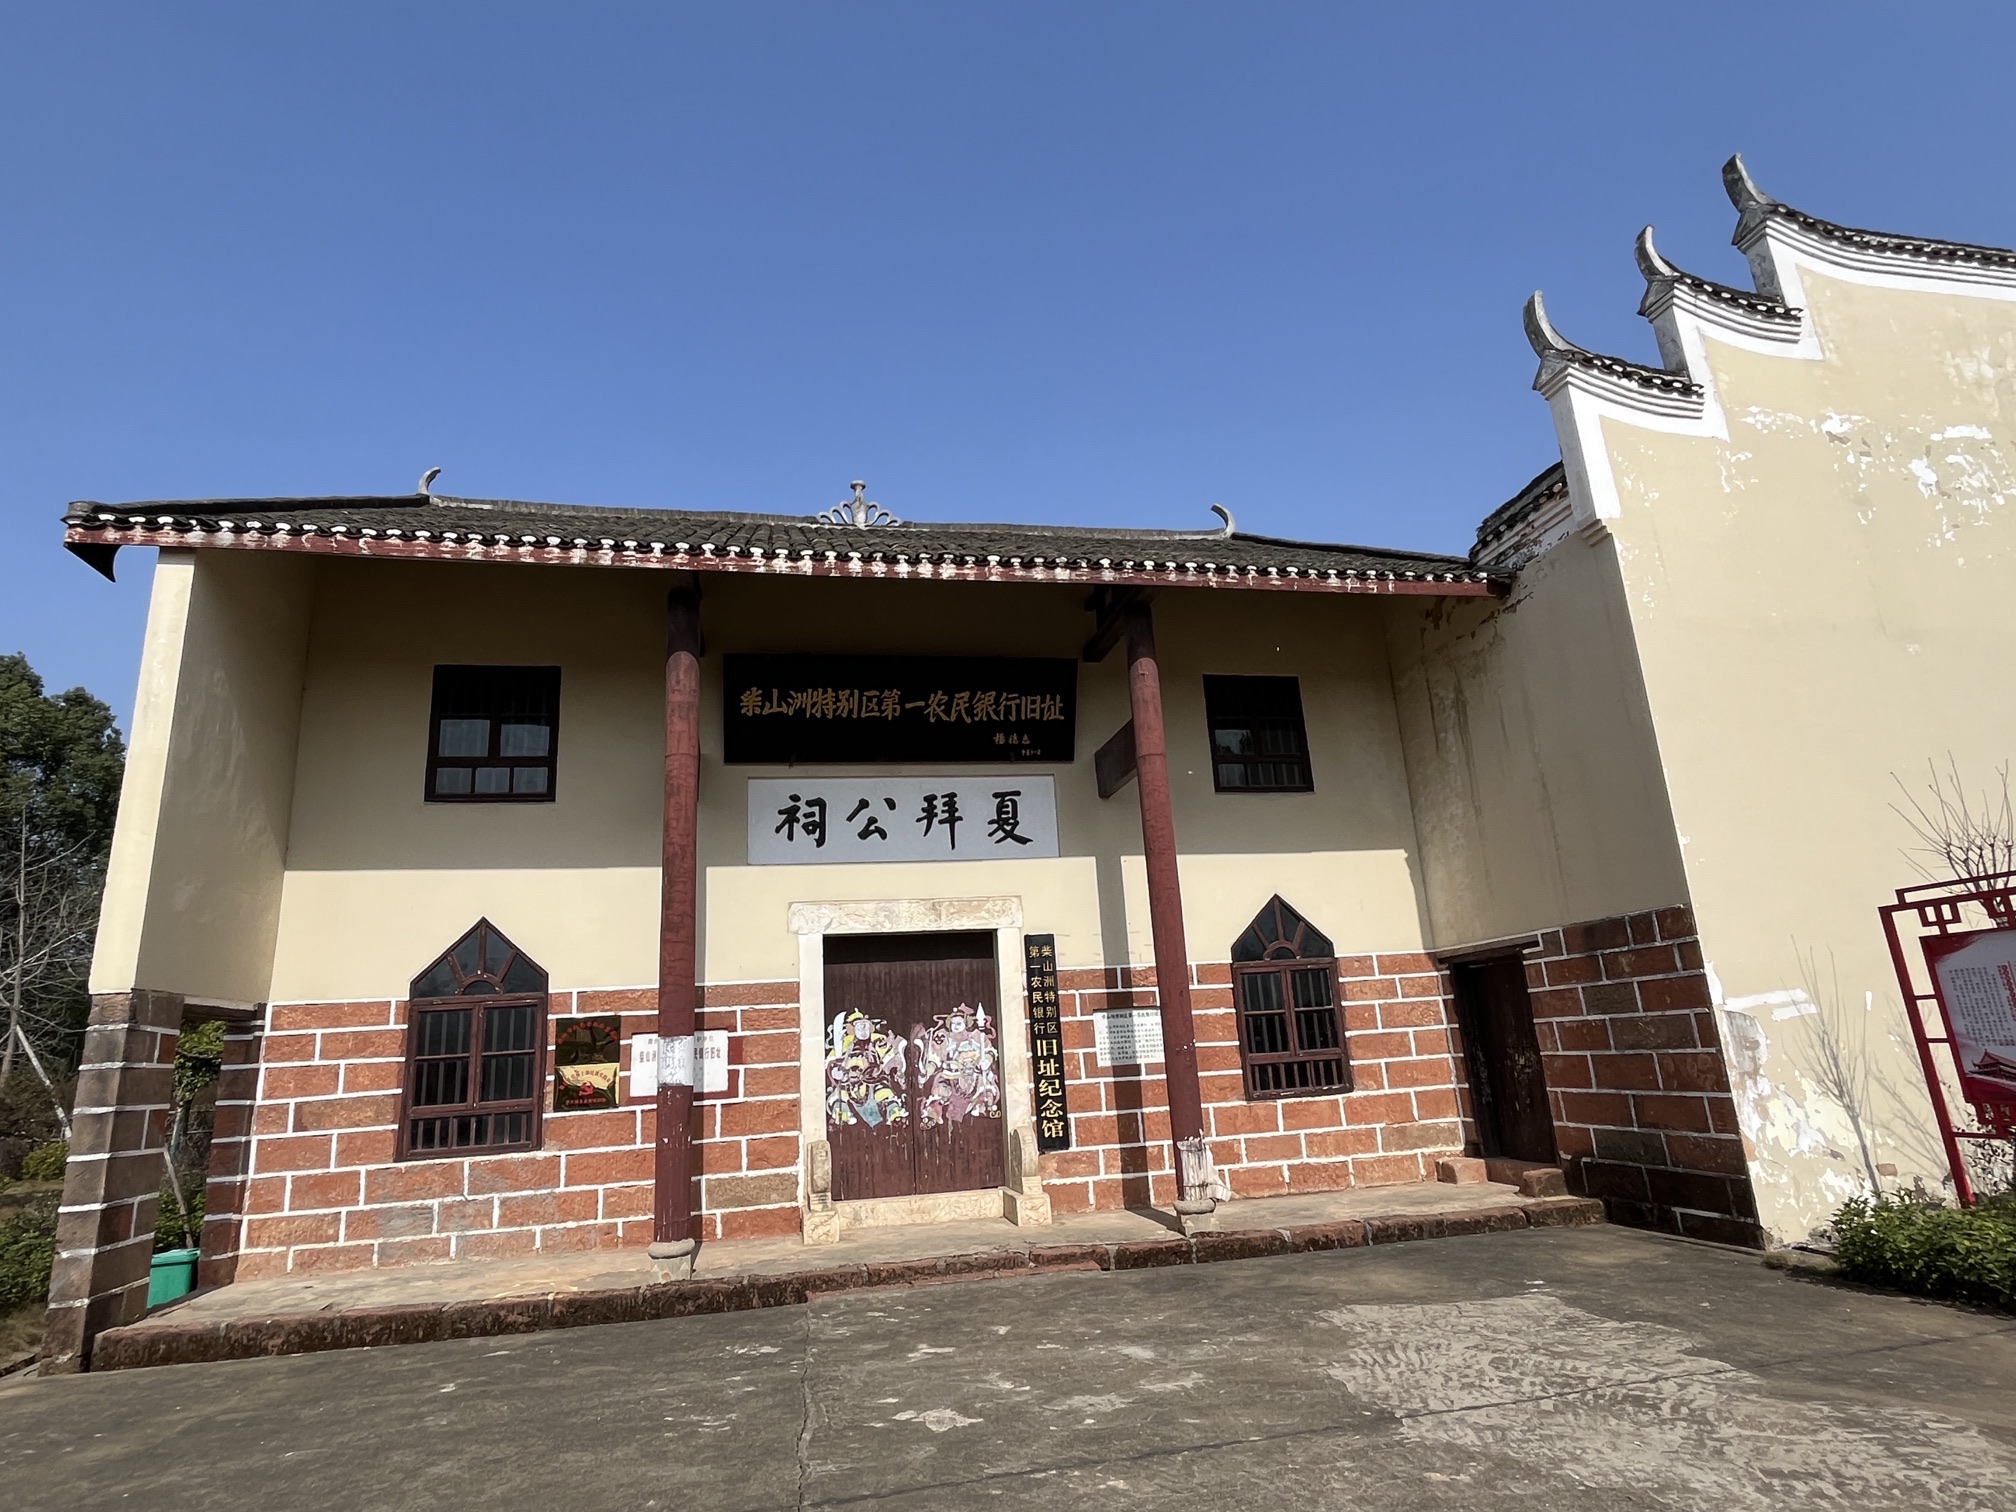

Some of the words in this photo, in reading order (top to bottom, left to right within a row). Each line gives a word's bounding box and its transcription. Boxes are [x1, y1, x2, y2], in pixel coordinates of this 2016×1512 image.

[1028, 945, 1046, 1035] 第一农民银行
[1041, 944, 1058, 1035] 柴山洲特别区
[1036, 1038, 1066, 1139] 旧址纪念馆
